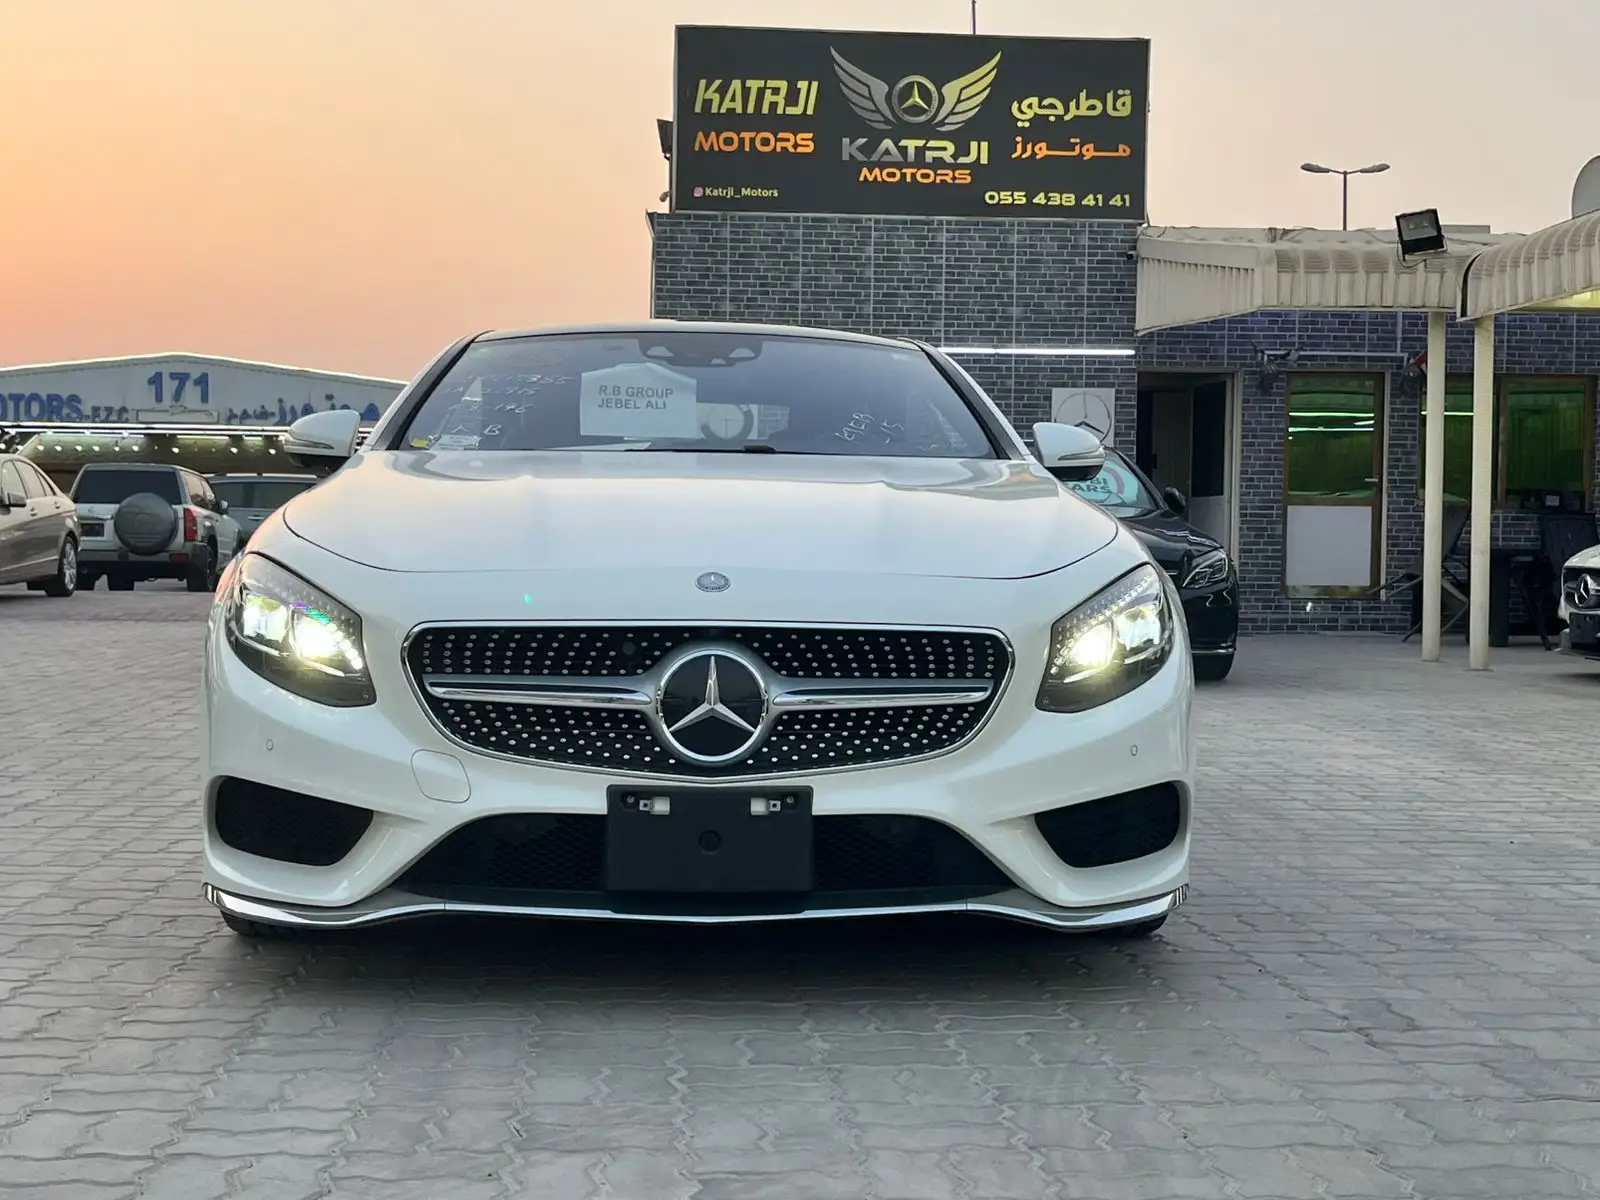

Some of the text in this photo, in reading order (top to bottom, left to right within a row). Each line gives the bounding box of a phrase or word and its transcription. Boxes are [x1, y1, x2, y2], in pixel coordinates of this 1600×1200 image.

[693, 78, 819, 115] KATRJI
[1011, 88, 1132, 128] قاطرجي
[694, 130, 816, 154] MOTORS
[841, 137, 989, 165] KATRJI
[1011, 135, 1132, 161] موتورز
[858, 166, 972, 185] MOTORS
[984, 190, 1131, 207] 055 438 41 41
[147, 371, 209, 404] 171
[598, 384, 675, 399] R.B GROUP
[597, 397, 667, 410] JEBEL ALI
